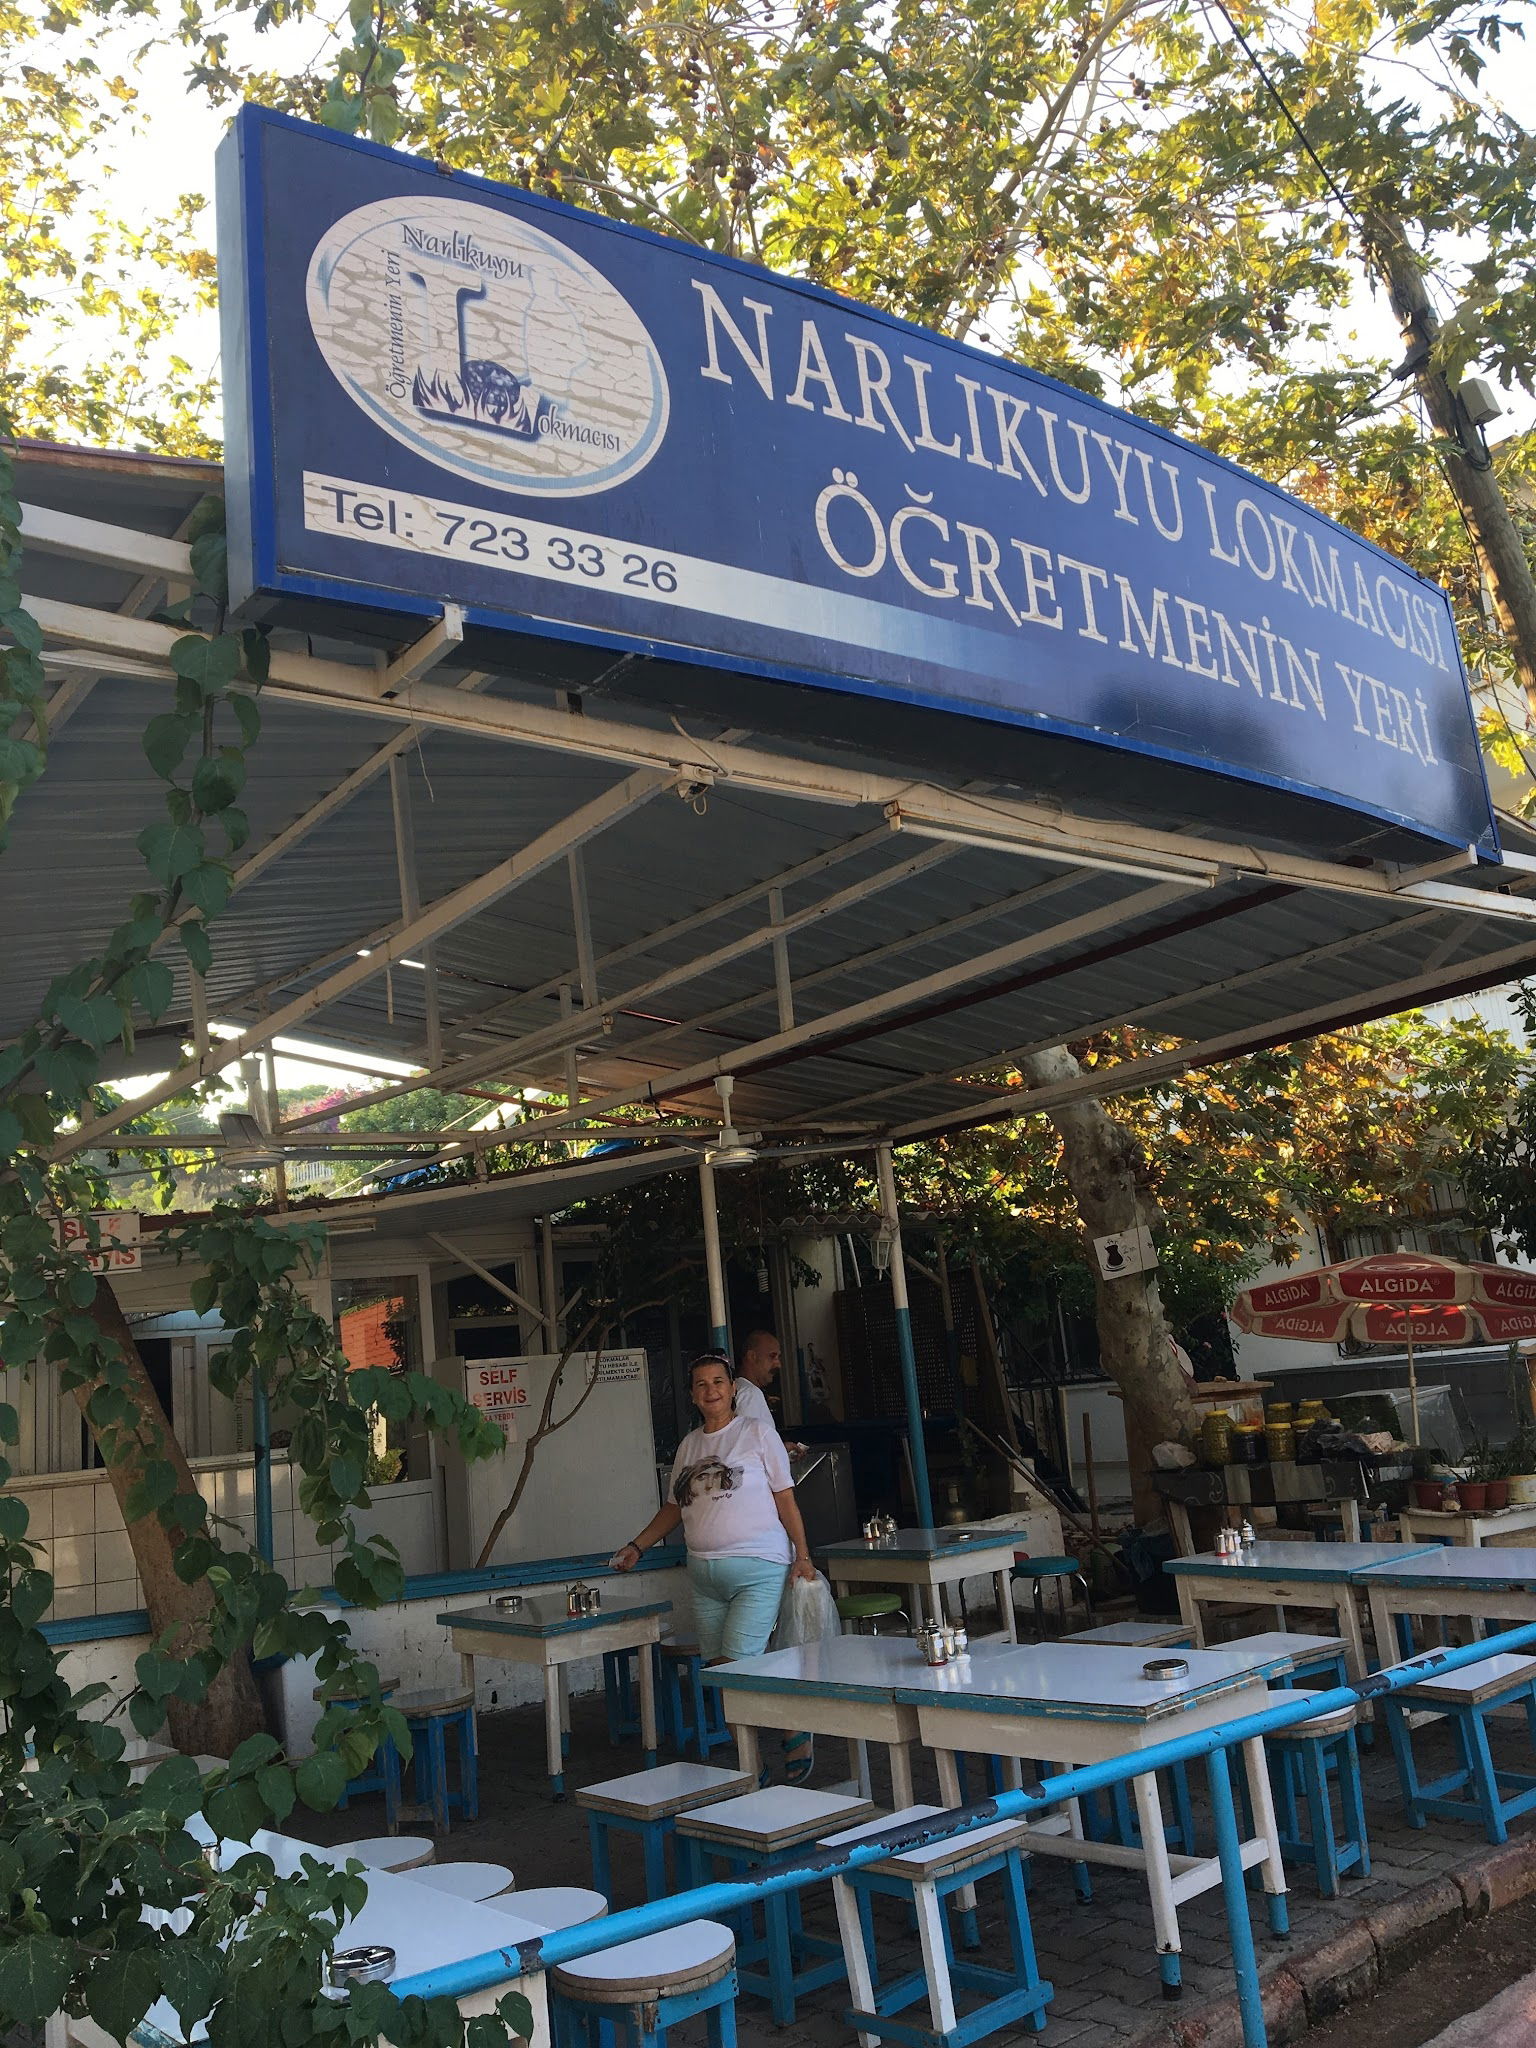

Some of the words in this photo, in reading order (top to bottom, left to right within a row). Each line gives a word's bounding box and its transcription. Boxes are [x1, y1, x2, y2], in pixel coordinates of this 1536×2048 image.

[381, 250, 402, 286] Yeri
[384, 294, 412, 398] Öğretmenin
[691, 278, 1184, 542] NARLIKUYU
[1197, 477, 1449, 672] LOKMACISI
[321, 485, 414, 538] Tel:
[436, 512, 530, 561] 723
[547, 537, 605, 577] 33
[622, 553, 678, 593] 26
[815, 467, 1327, 721] ÖĞRETMENİN
[1334, 661, 1438, 767] YERİ
[473, 1386, 527, 1408] SERVİS
[480, 1370, 517, 1386] SELF
